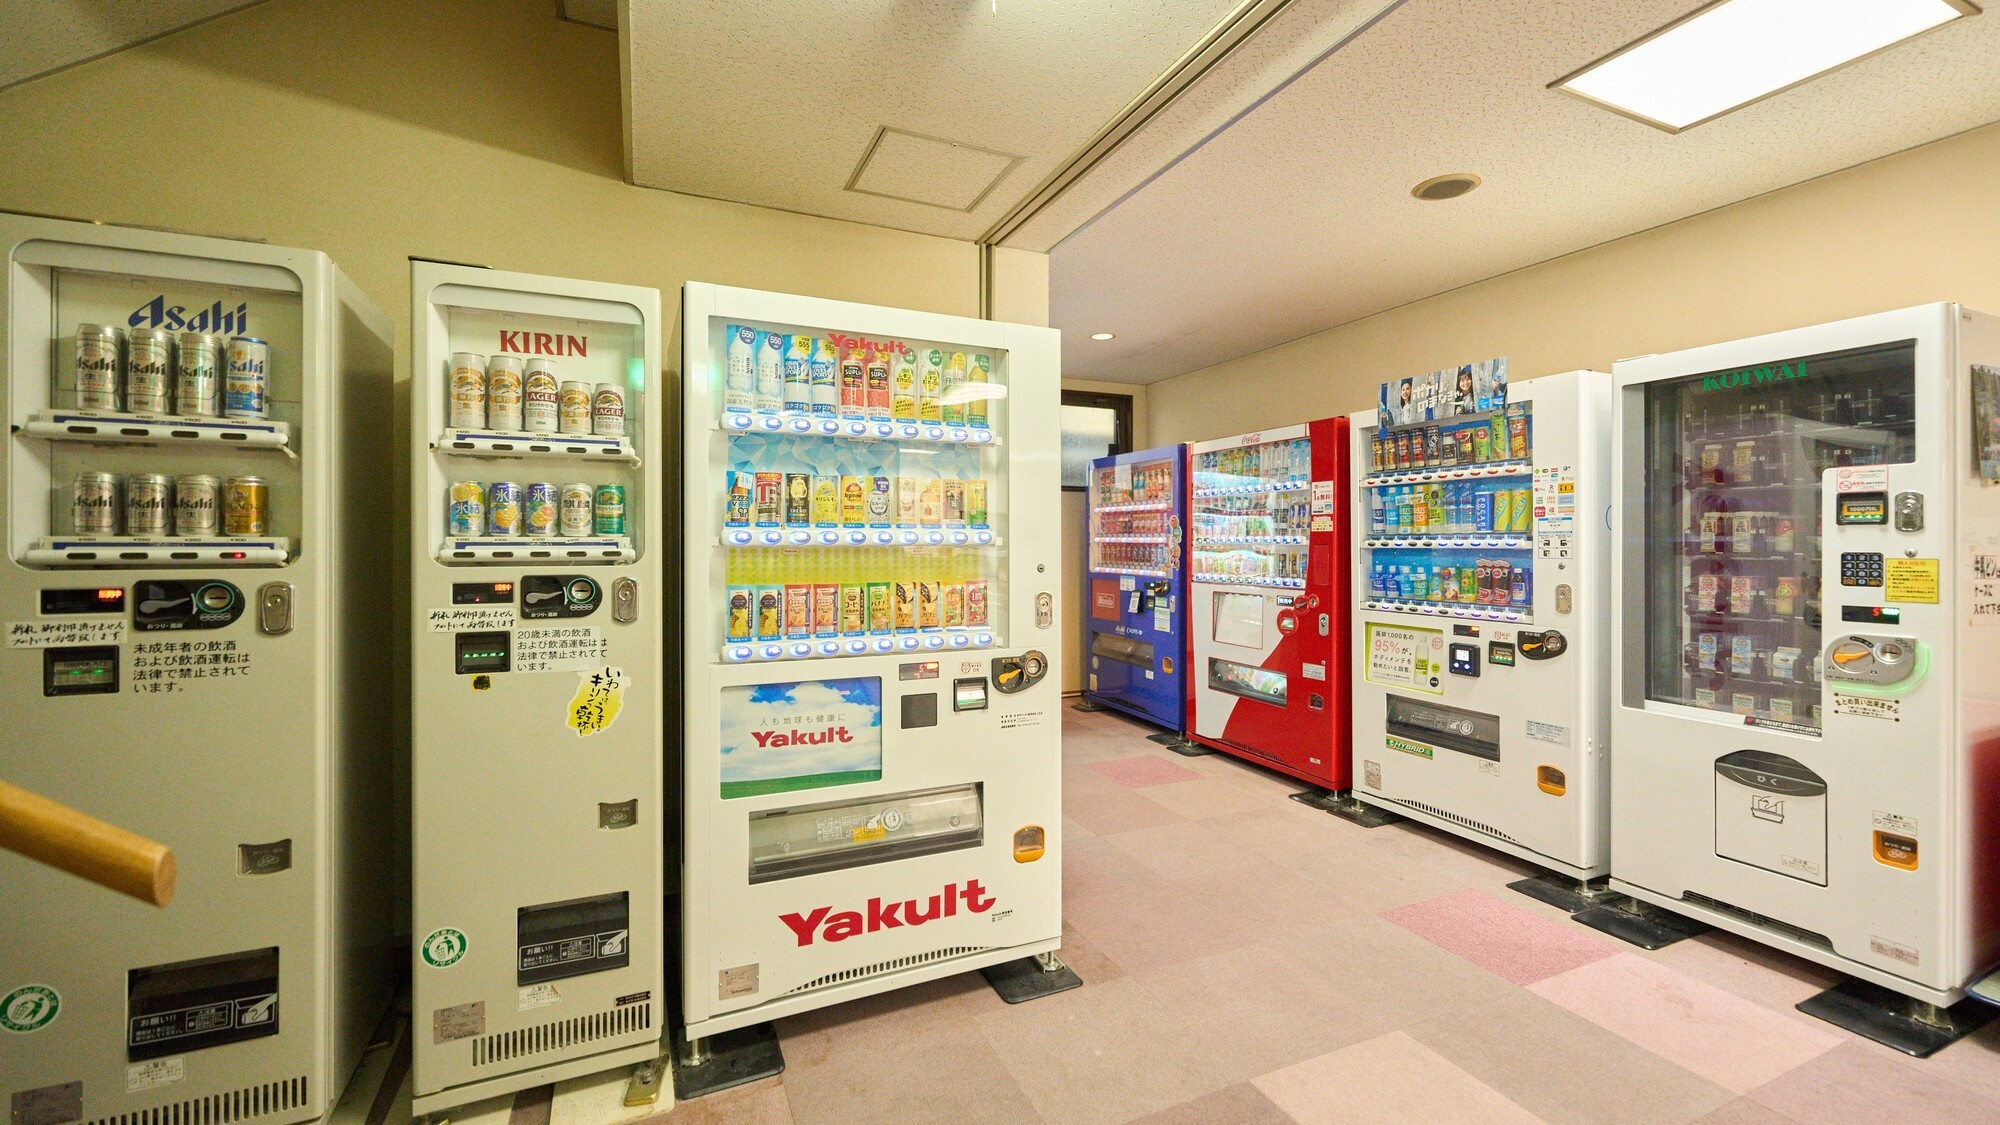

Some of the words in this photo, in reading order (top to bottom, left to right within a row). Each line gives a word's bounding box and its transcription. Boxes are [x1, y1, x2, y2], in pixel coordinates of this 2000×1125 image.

[128, 294, 247, 336] Asahi
[741, 330, 754, 339] 550
[769, 335, 782, 345] 550
[499, 330, 587, 358] KIRIN
[827, 333, 911, 355] Yakult
[229, 359, 263, 375] sahi
[1703, 360, 1808, 391] KOIWAI
[526, 392, 557, 402] LAGER
[595, 408, 622, 416] LAGER
[495, 489, 521, 502] 氷結
[532, 488, 558, 502] 氷結
[456, 502, 480, 515] 氷結
[517, 628, 591, 639] 20歳未満の飲酒
[1375, 630, 1415, 641] 医師1,000名の
[133, 640, 237, 654] 未成年者の飲酒
[517, 639, 597, 649] および飲酒運転は
[133, 652, 251, 667] および飲酒運転は
[517, 650, 598, 661] 法律で禁止されて
[133, 664, 251, 681] 法律で禁止されて
[517, 662, 553, 672] います。
[133, 682, 186, 693] います。
[759, 713, 846, 727] 人も地球も健康に
[750, 726, 854, 749] Yakult
[1393, 741, 1425, 754] HYBRID
[778, 878, 997, 948] Yakult
